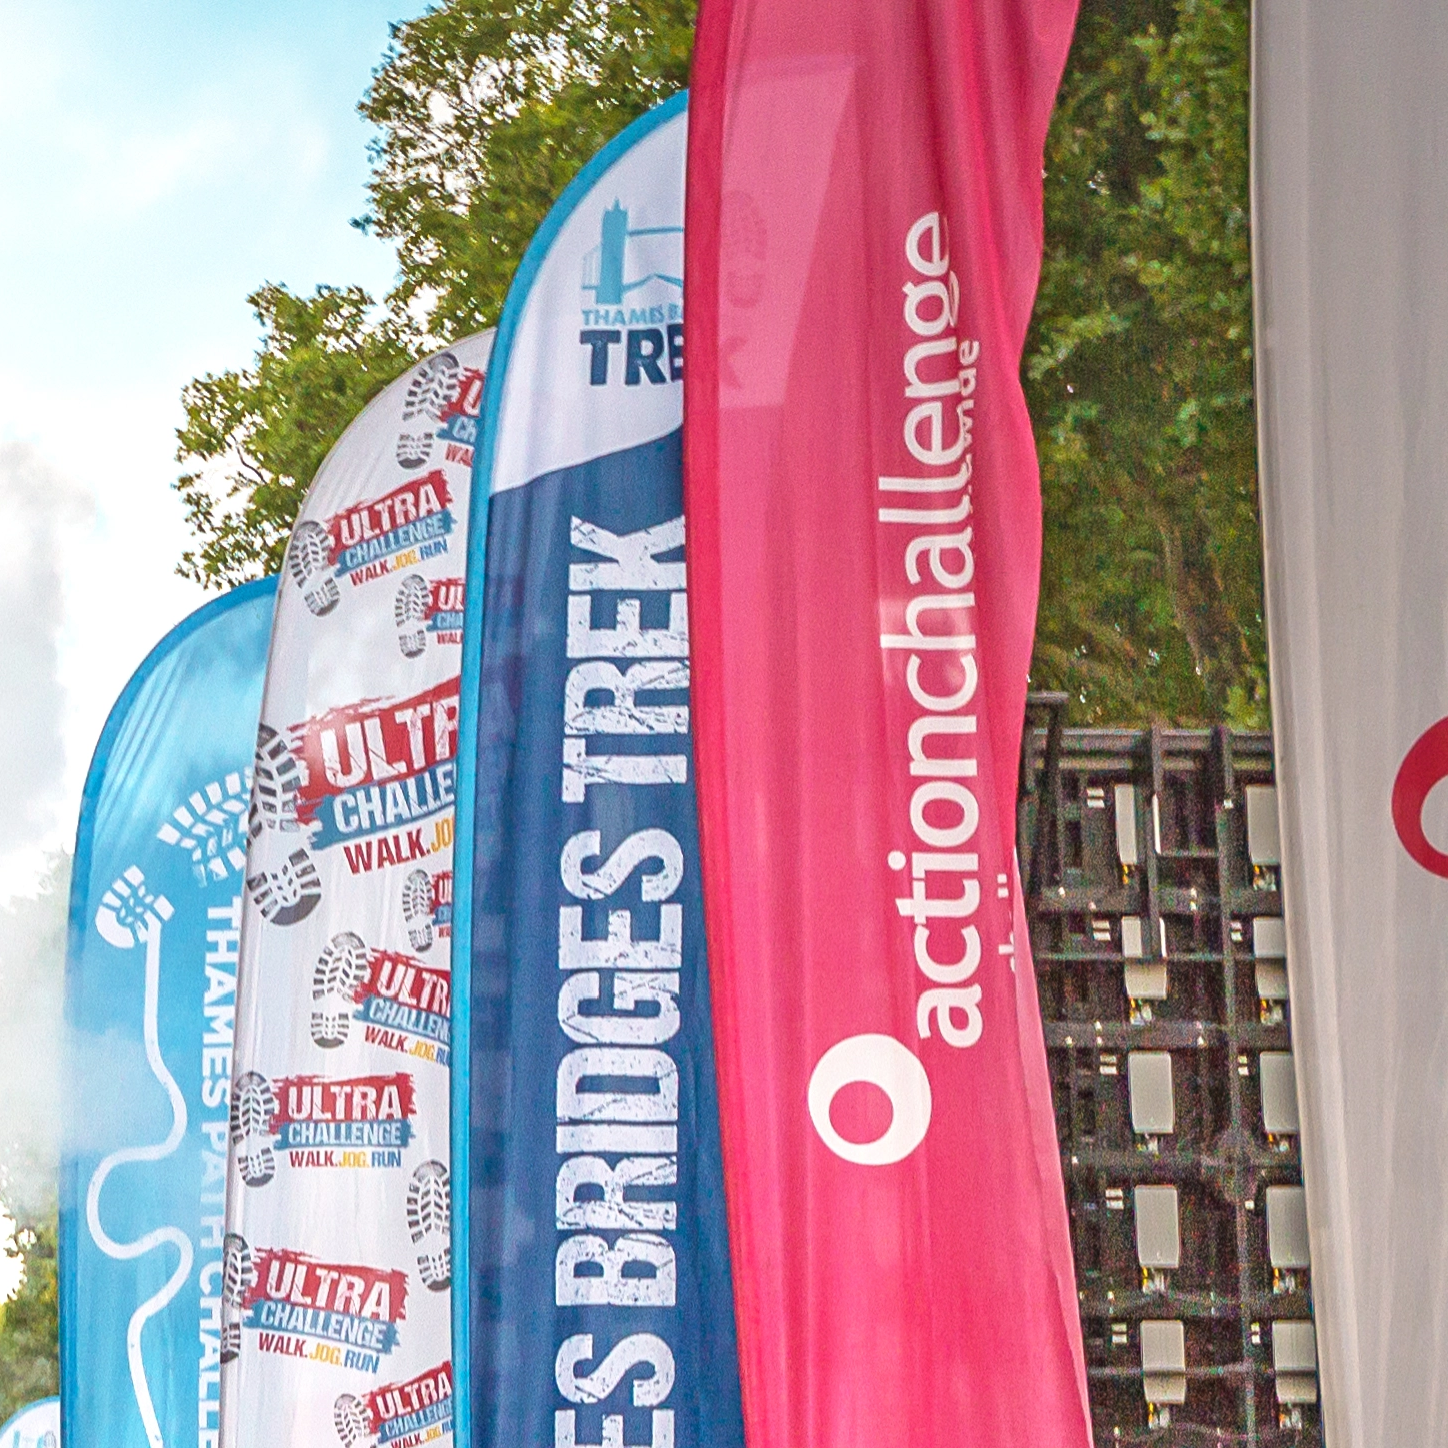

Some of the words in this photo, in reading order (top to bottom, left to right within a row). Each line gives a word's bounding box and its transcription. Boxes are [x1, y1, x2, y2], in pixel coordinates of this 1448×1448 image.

[579, 323, 685, 386] TRE
[339, 482, 443, 547] ULTRA
[344, 515, 446, 569] CHALLENGE
[561, 515, 691, 803] TREK
[878, 211, 983, 1048] actionchallenge
[320, 695, 459, 789] ULTR
[333, 761, 455, 835] CHALLE
[201, 899, 242, 1109] THAMES
[555, 828, 684, 1307] BRIDGES
[288, 1084, 403, 1121] ULTRA
[288, 1120, 402, 1146] CHALLENGE
[266, 1259, 390, 1323] ULTRA
[260, 1301, 387, 1349] CHALLENGE
[375, 1371, 452, 1420] ULTRA
